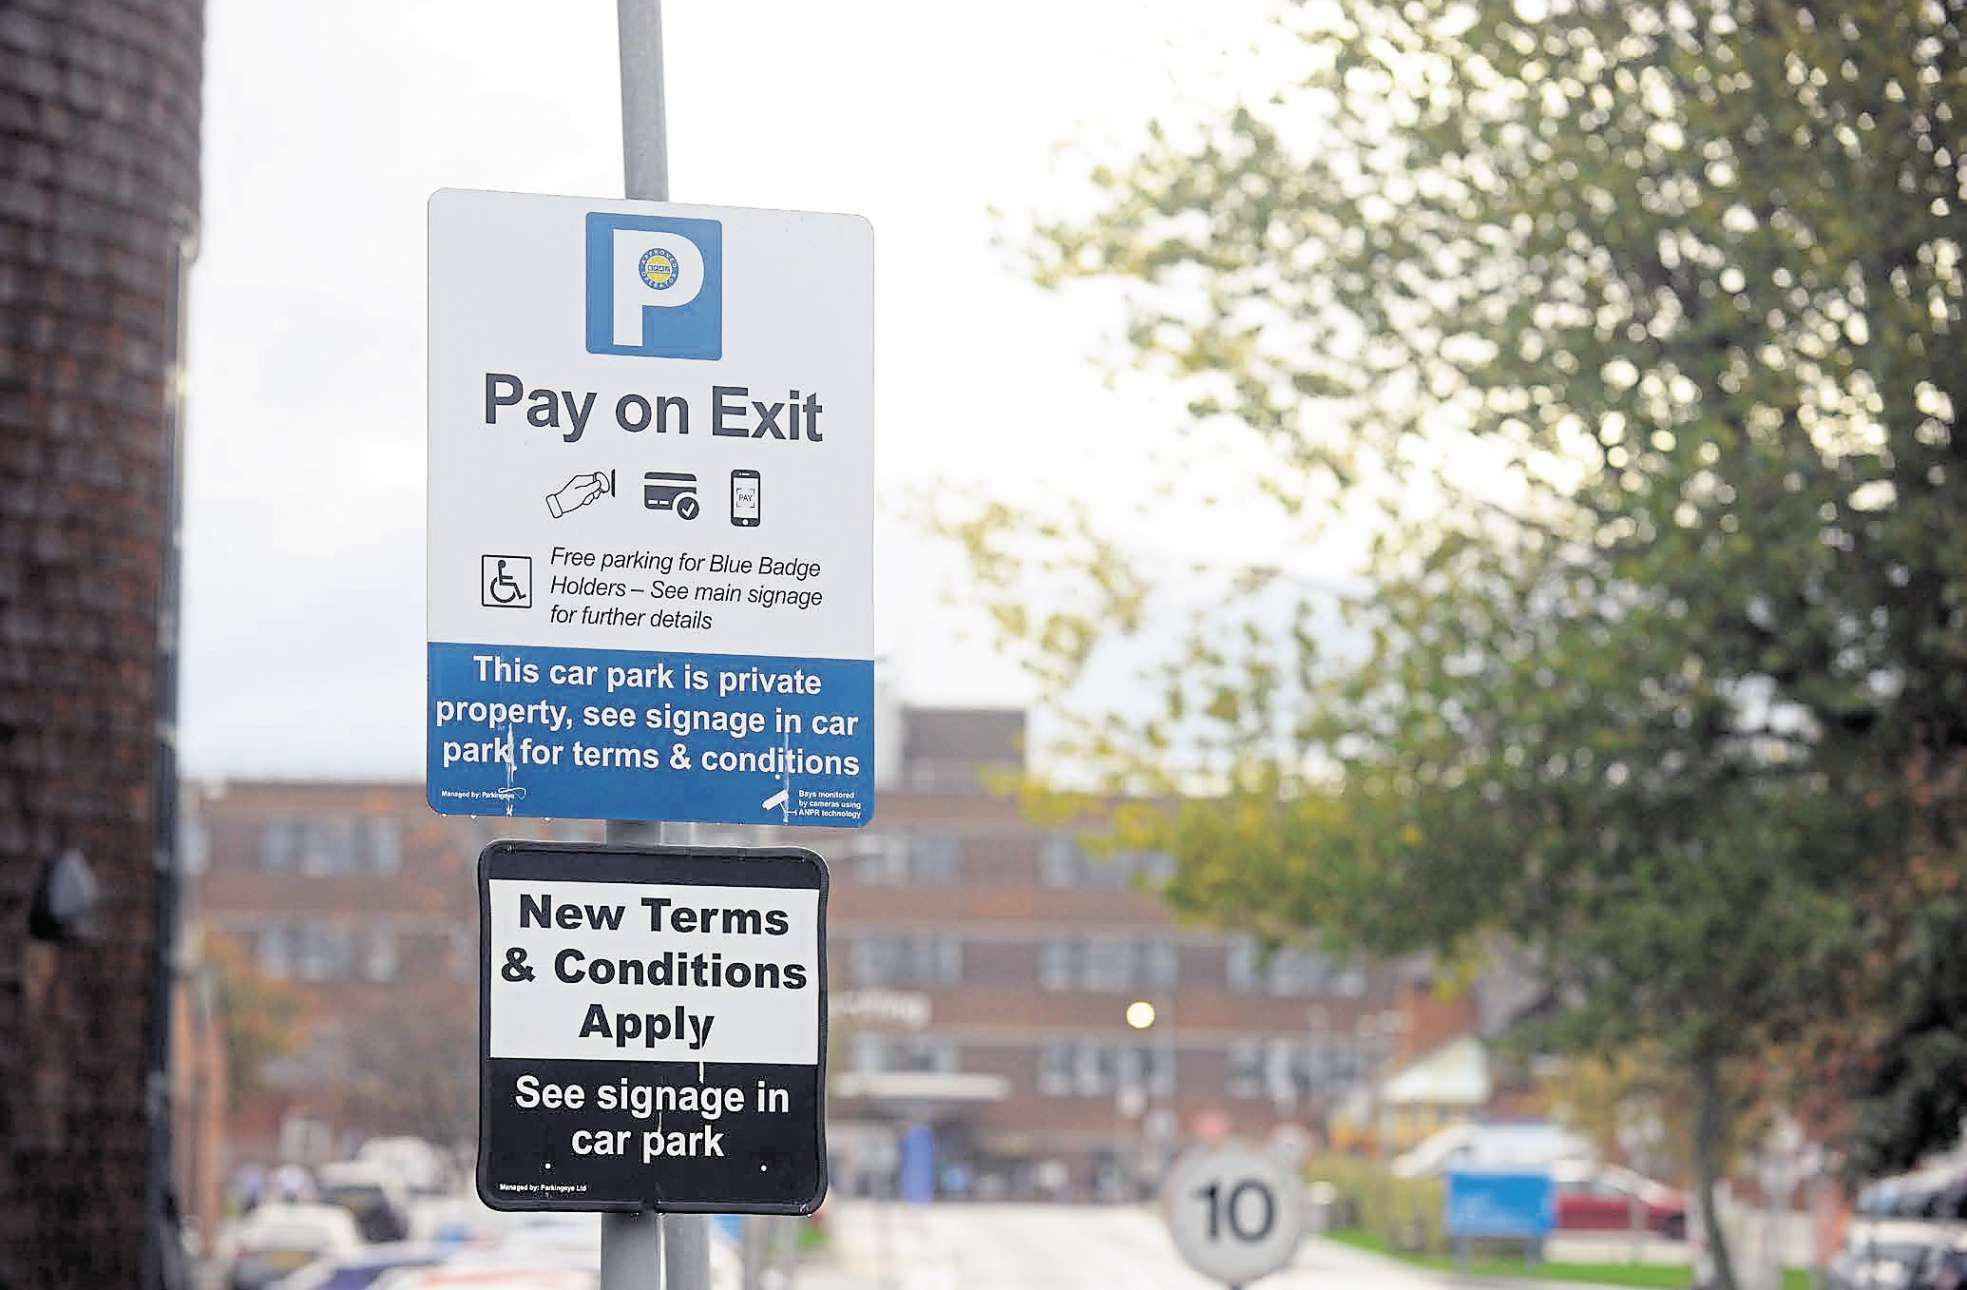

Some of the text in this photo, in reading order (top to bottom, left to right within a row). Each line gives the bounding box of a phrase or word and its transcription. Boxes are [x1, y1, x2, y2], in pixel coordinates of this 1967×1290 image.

[612, 229, 705, 346] P
[485, 373, 824, 443] Pay on Exit
[739, 494, 753, 502] PAY
[551, 547, 821, 582] Free parking for Blue Badge
[551, 576, 627, 597] Holders
[651, 580, 690, 600] See
[695, 583, 744, 602] main
[748, 586, 823, 609] signage
[550, 605, 713, 630] for further details
[473, 655, 823, 697] This car park is private
[436, 699, 860, 738] property, see signage in car
[442, 739, 860, 777] park for terms & conditions
[441, 790, 470, 799] Managed
[798, 790, 855, 799] Bays monitored
[798, 800, 809, 808] by
[841, 801, 861, 810] using
[798, 809, 861, 819] ANPR technology
[519, 893, 790, 936] New Terms
[501, 947, 808, 990] & Conditions
[578, 1003, 715, 1050] Apply
[515, 1075, 789, 1121] See signage in
[571, 1125, 725, 1164] car park
[499, 1183, 528, 1192] Managed
[1194, 1179, 1276, 1243] 10
